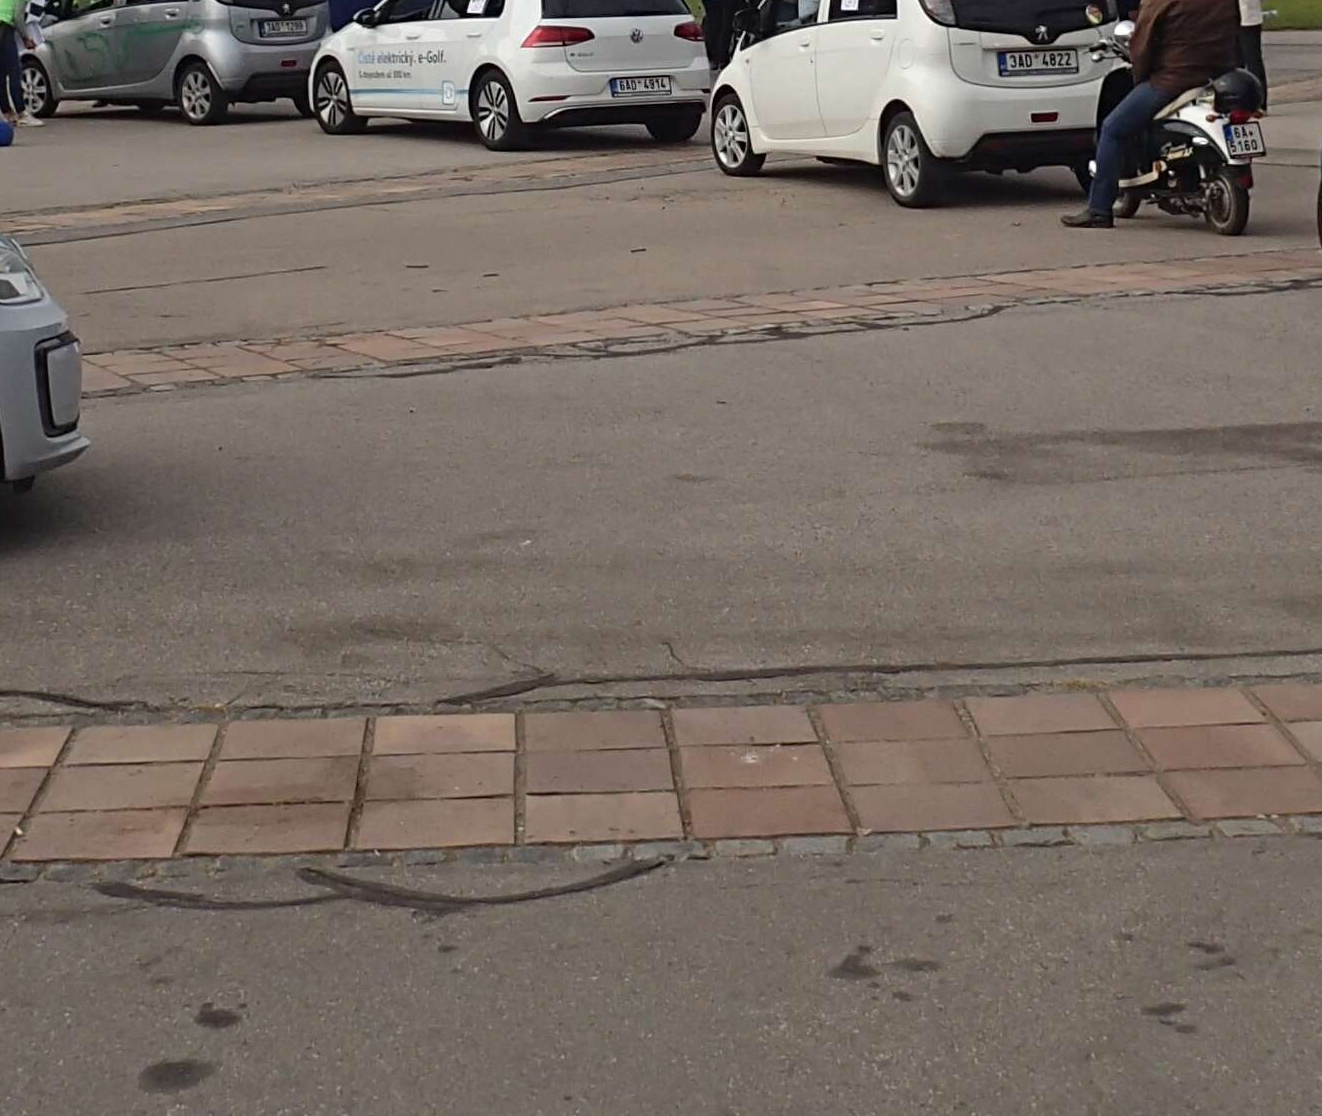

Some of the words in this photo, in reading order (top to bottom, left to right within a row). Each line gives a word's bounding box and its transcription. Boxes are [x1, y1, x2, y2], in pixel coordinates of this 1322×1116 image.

[418, 50, 447, 64] e-Golf.
[1009, 54, 1033, 68] 3AD
[1042, 52, 1072, 67] 4822
[619, 79, 637, 91] 6AD
